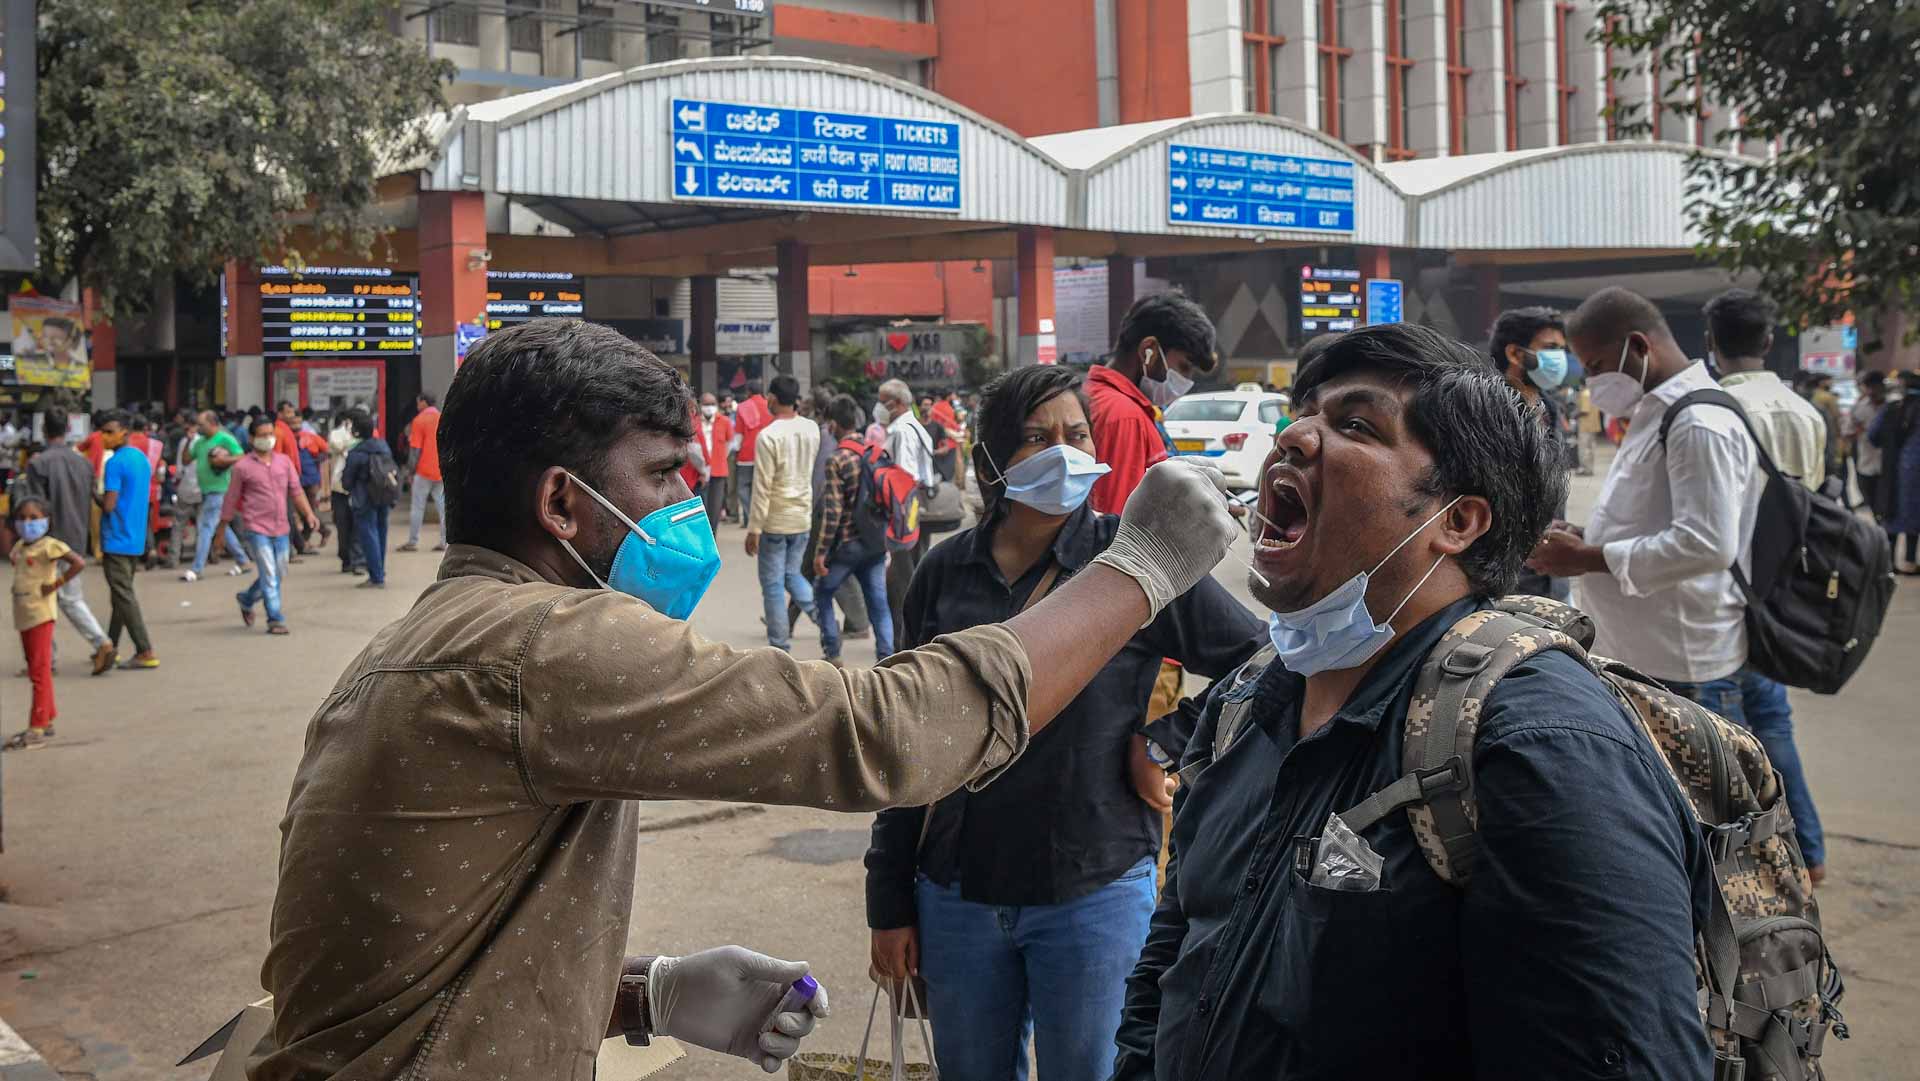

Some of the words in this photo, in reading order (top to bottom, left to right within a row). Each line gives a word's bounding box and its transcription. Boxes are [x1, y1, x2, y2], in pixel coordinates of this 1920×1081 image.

[813, 115, 868, 140] टिकट
[894, 123, 949, 145] TICKETS
[884, 153, 907, 171] FOOT
[907, 154, 929, 173] OVER
[930, 156, 959, 175] BRIDGE
[840, 179, 871, 201] कार्ट
[892, 182, 927, 201] FERRY
[927, 184, 955, 203] CART
[1318, 210, 1340, 226] EXIT
